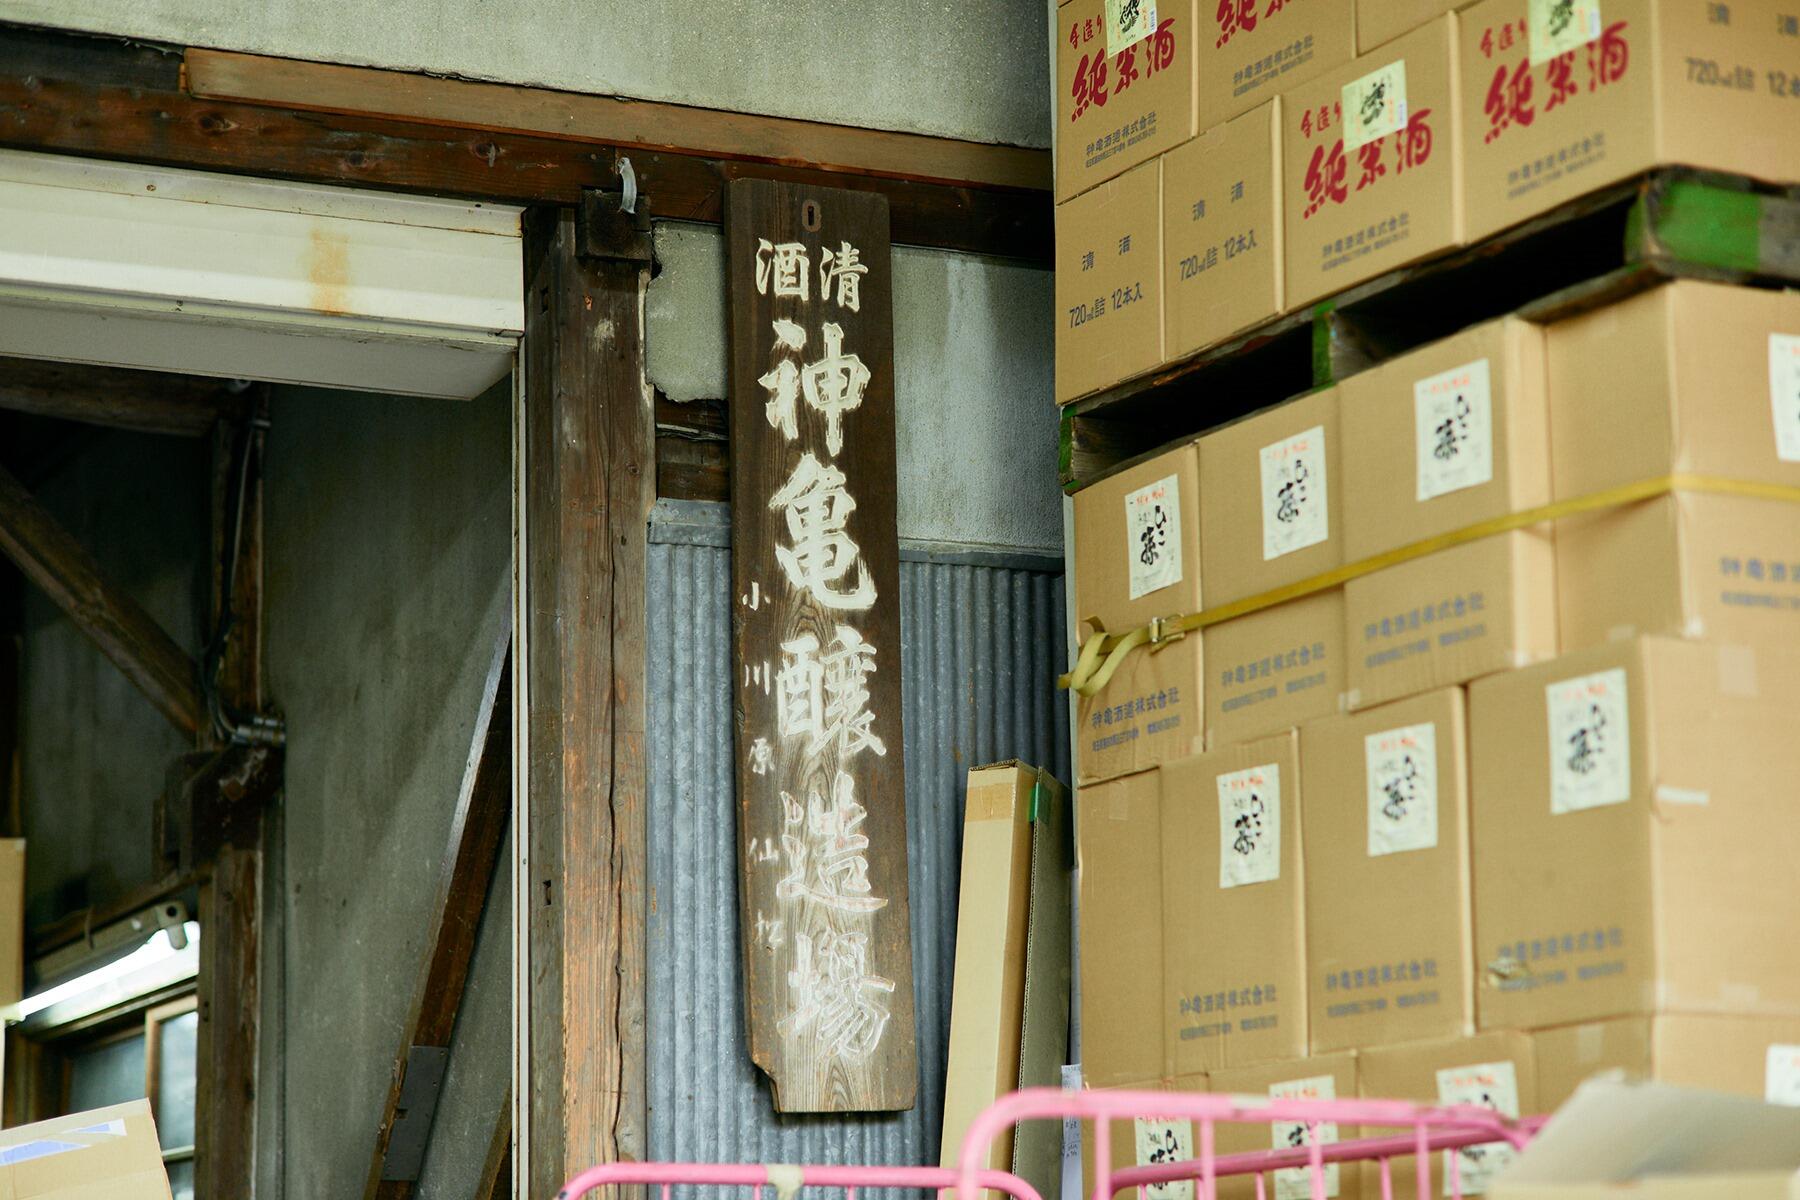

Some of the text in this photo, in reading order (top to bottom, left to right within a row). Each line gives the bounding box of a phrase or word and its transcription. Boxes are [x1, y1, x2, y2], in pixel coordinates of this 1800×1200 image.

[1071, 18, 1175, 122] 純米酒
[1484, 21, 1628, 144] 純米酒
[1304, 108, 1431, 219] 純米酒
[1112, 282, 1142, 311] 12本入
[1225, 230, 1257, 261] 12本入
